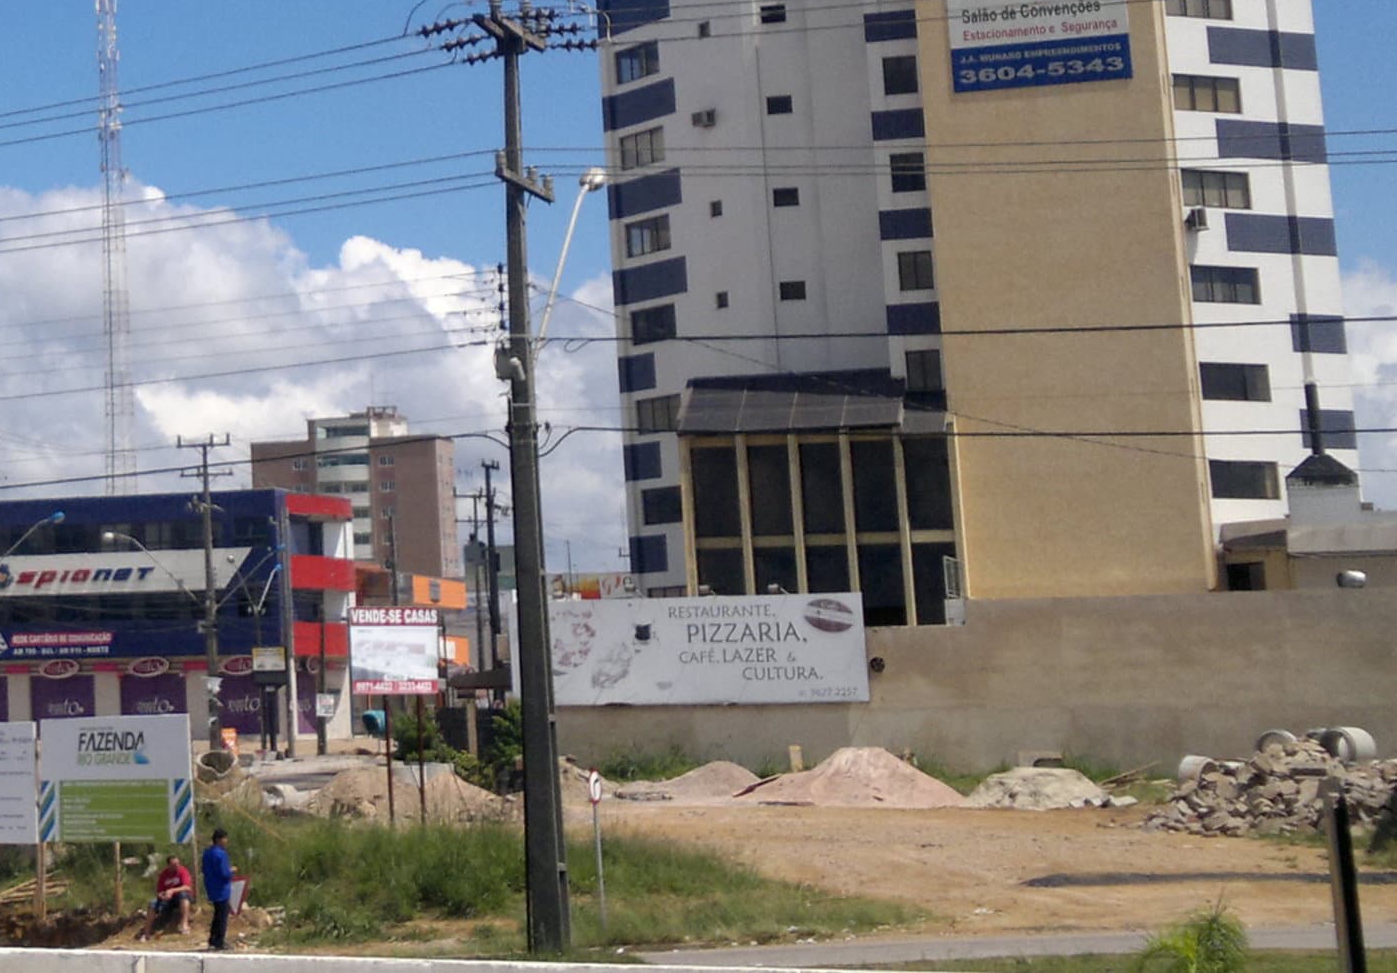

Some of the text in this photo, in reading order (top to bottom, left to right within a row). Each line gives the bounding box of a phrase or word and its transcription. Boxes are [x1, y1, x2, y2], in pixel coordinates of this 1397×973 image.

[961, 0, 1101, 25] Salão de Convenções
[963, 18, 1118, 42] Estacionamento e Segurança
[1024, 42, 1122, 60] EMPREENDIMENTOS
[959, 56, 1125, 85] 3604-5343
[352, 608, 438, 624] VENDE-SE CASAS
[687, 622, 809, 644] PIZZARIA,
[722, 647, 778, 664] LAZER
[742, 666, 824, 682] CULTURA.
[78, 730, 145, 752] FAZENDA
[78, 752, 131, 765] RIO GRANDE
